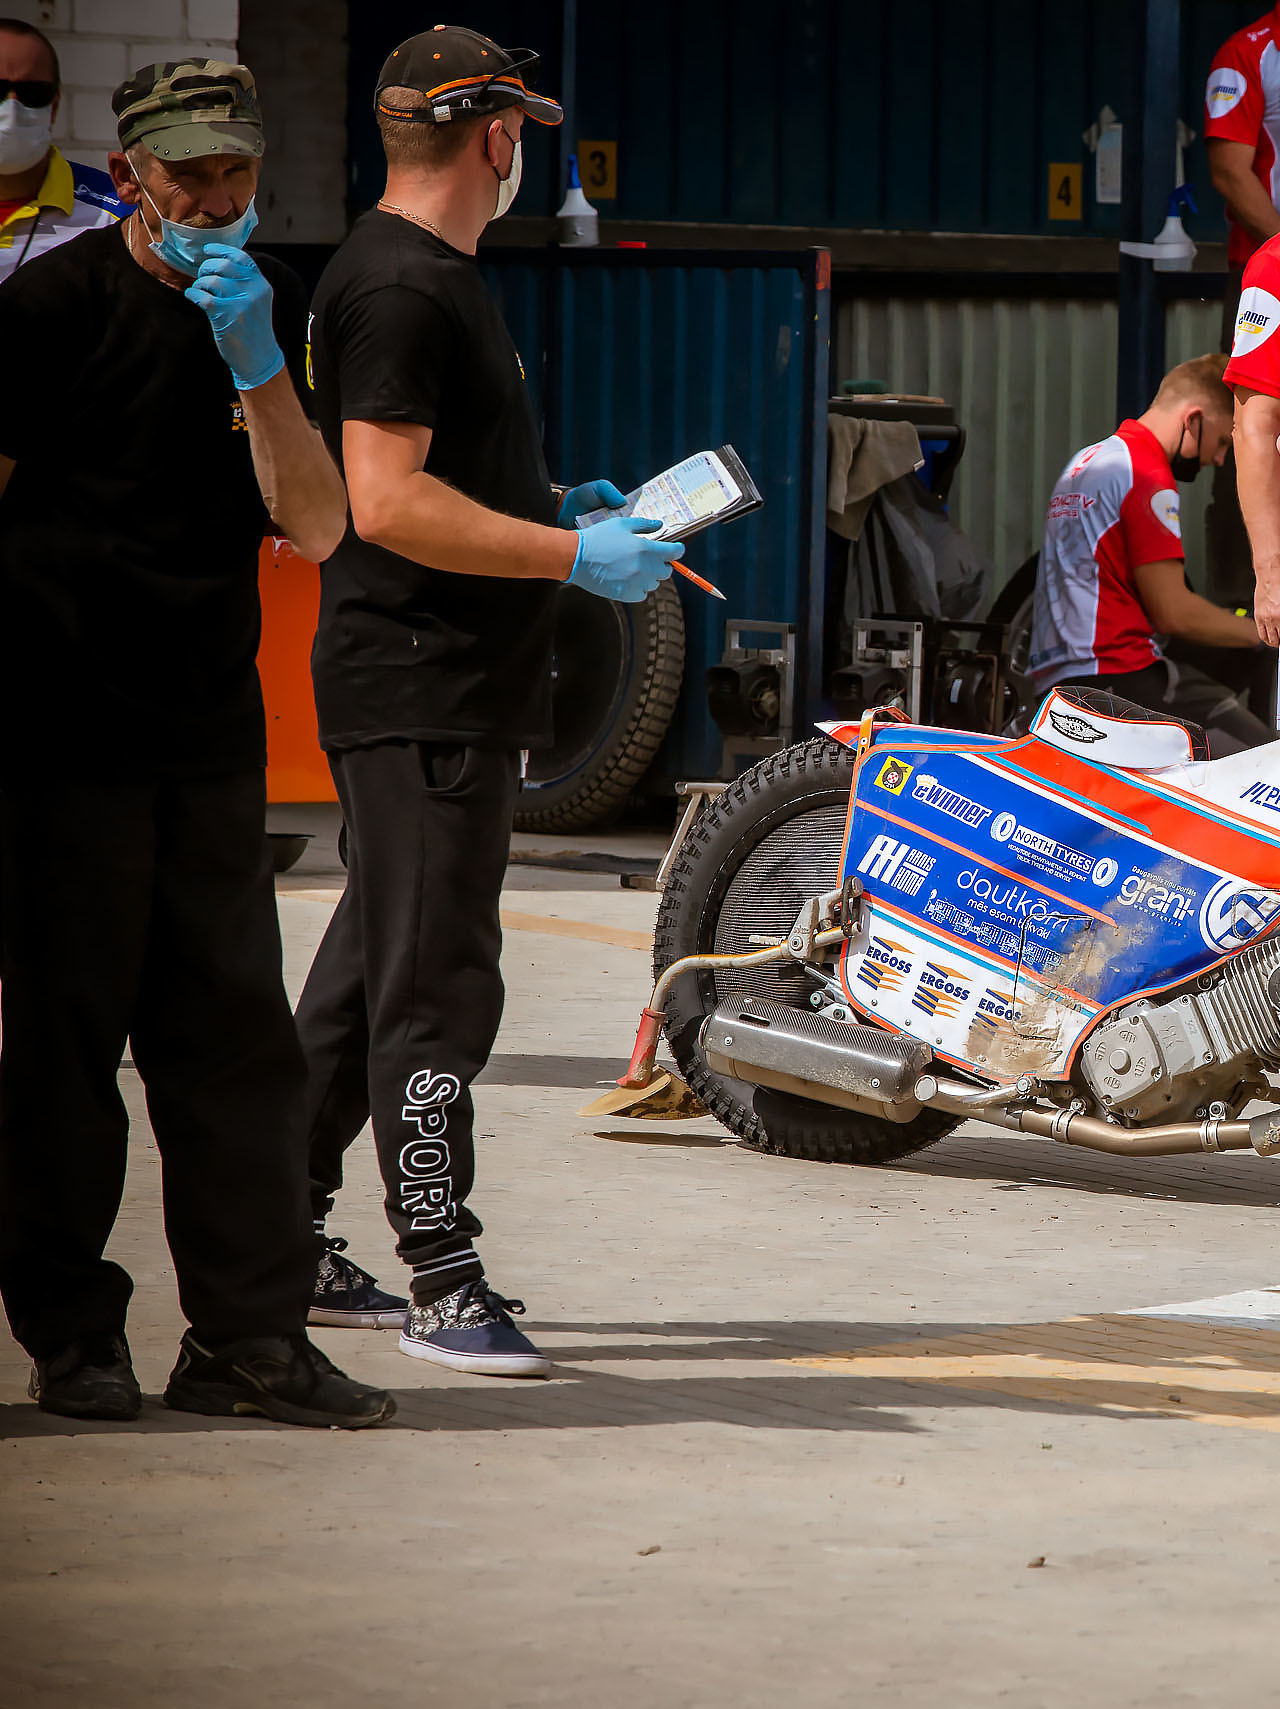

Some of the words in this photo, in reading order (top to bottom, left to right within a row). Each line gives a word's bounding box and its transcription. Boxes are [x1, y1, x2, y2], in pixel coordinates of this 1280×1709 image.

[590, 150, 608, 187] 3
[1057, 176, 1072, 206] 4
[1015, 829, 1054, 854] NORTH
[1056, 846, 1091, 871] TYRES
[967, 897, 989, 914] mēs
[989, 908, 1018, 927] esam
[866, 945, 913, 974] ERGOSS
[919, 971, 971, 1000] ERGOSS
[978, 998, 1022, 1021] ERGOS
